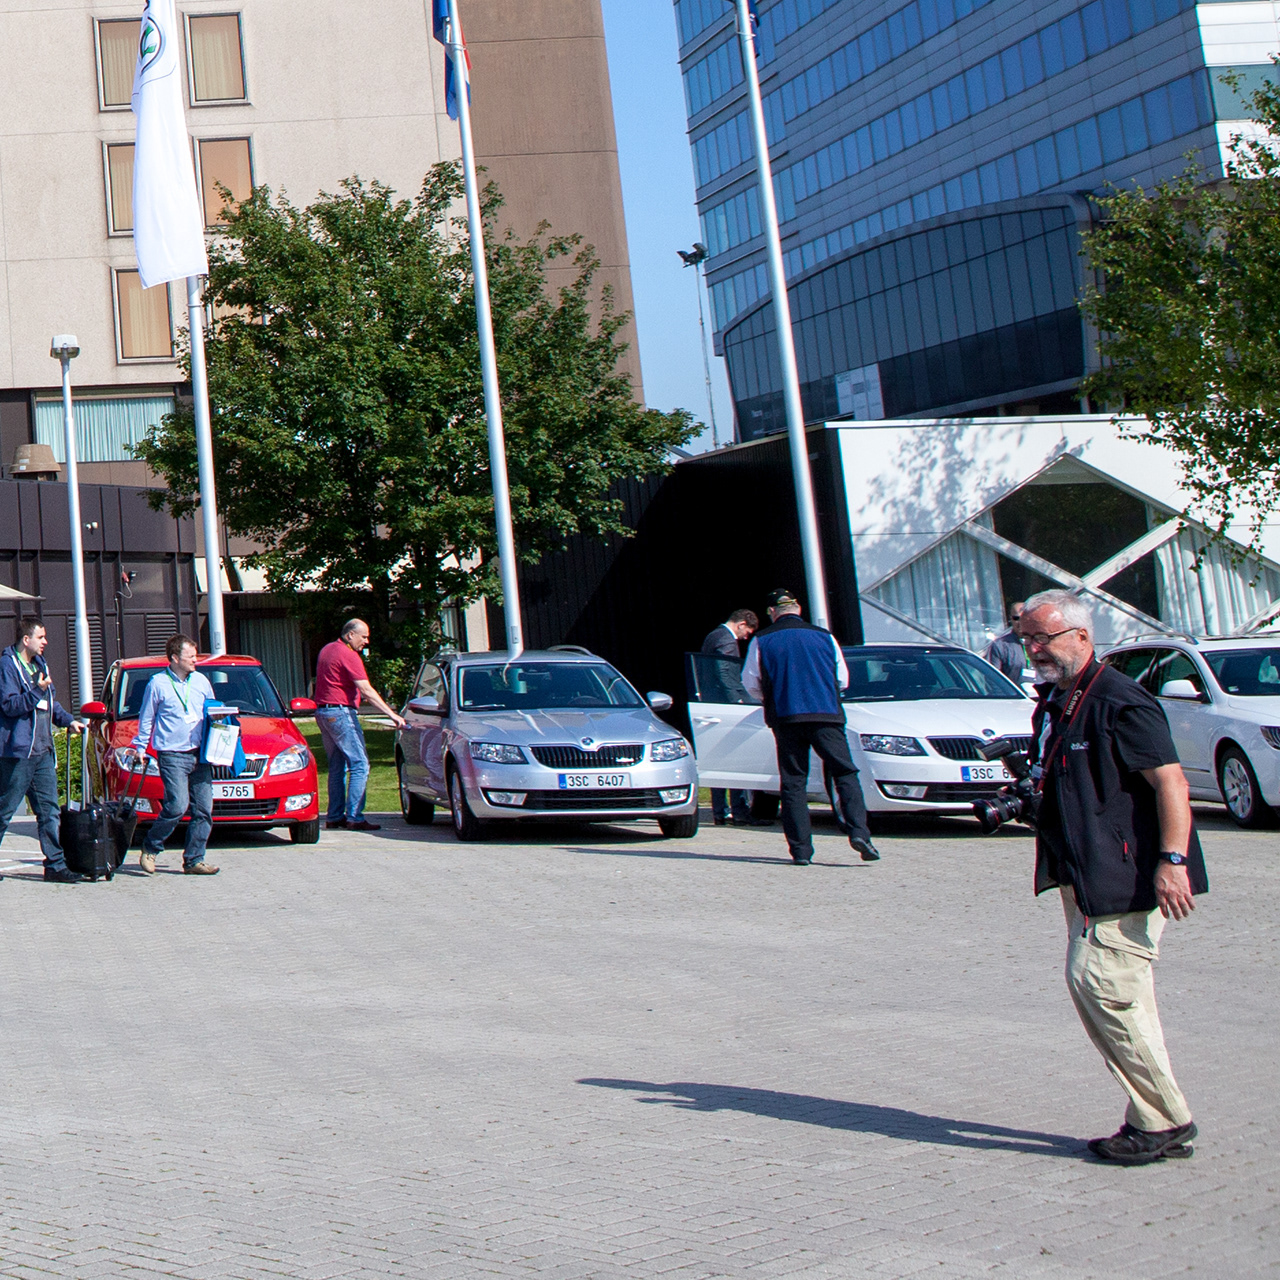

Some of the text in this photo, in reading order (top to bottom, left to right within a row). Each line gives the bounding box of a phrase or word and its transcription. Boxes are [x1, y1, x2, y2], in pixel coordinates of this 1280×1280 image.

[1065, 689, 1083, 715] Canon
[971, 768, 993, 779] 3SC
[568, 775, 624, 787] 3SC 6407
[222, 786, 249, 797] 5765
